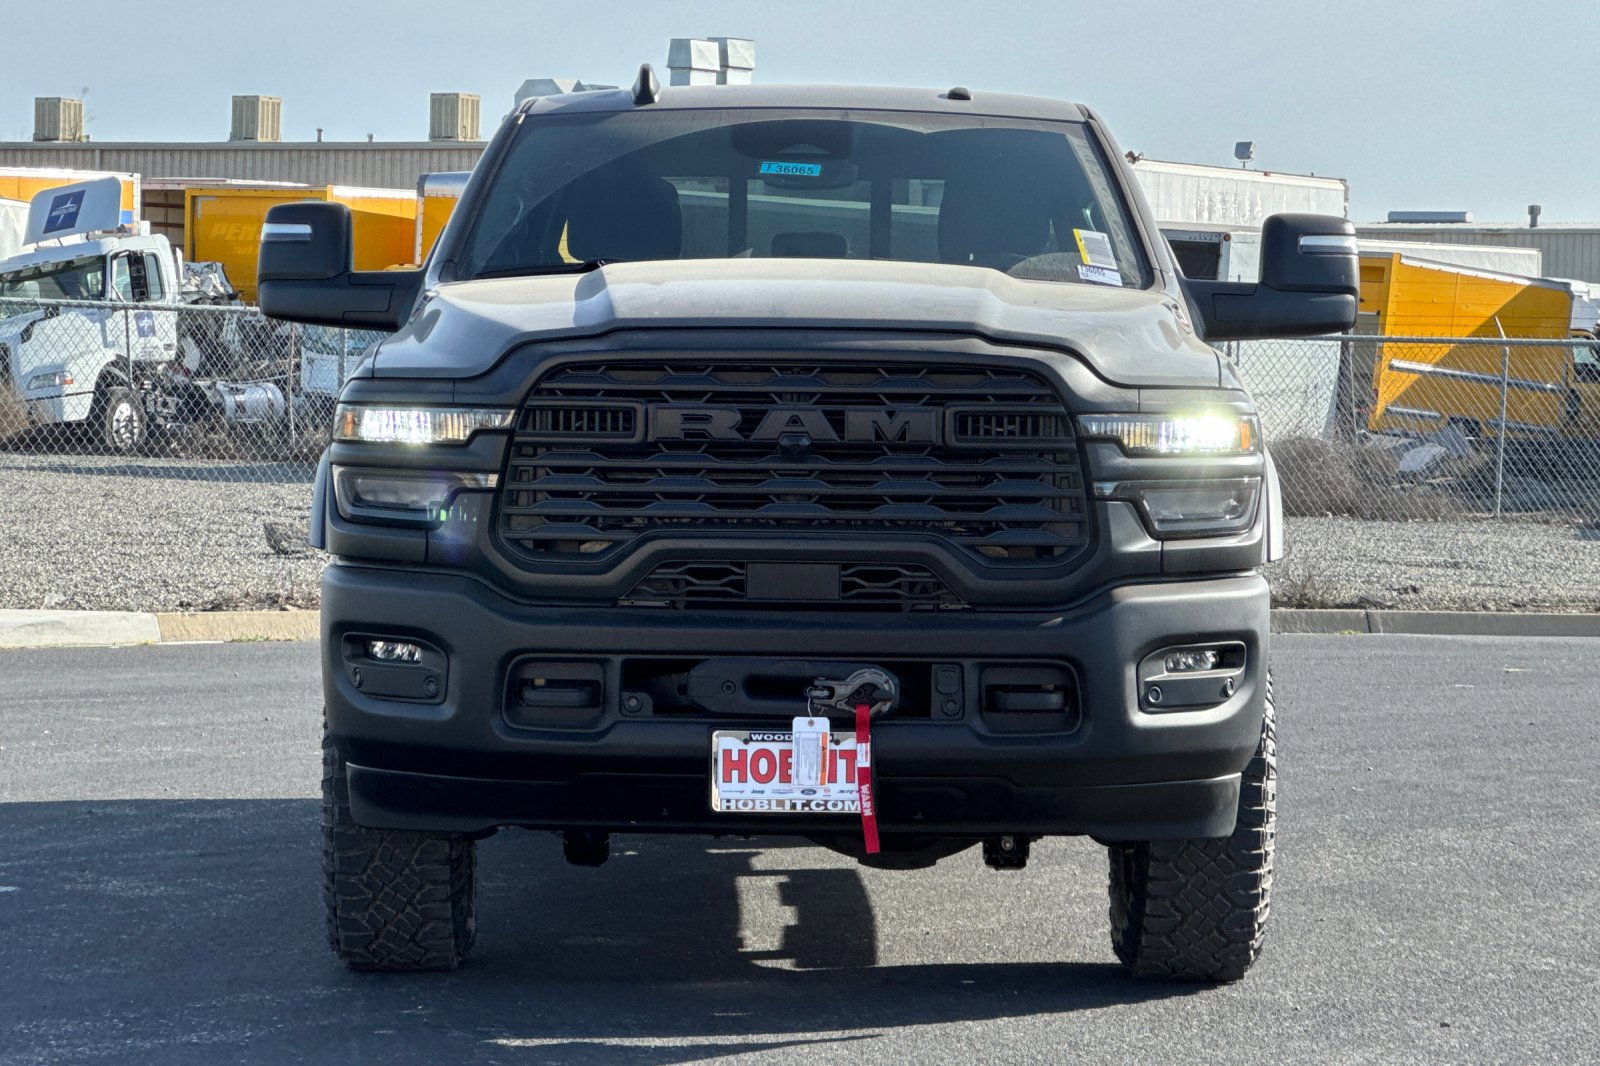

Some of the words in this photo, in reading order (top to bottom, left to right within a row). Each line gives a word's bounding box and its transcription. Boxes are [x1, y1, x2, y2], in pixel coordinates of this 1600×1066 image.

[775, 165, 814, 175] 36065
[653, 406, 940, 444] RAM
[721, 800, 861, 811] HOBLIT.COM
[860, 784, 873, 817] WARN
